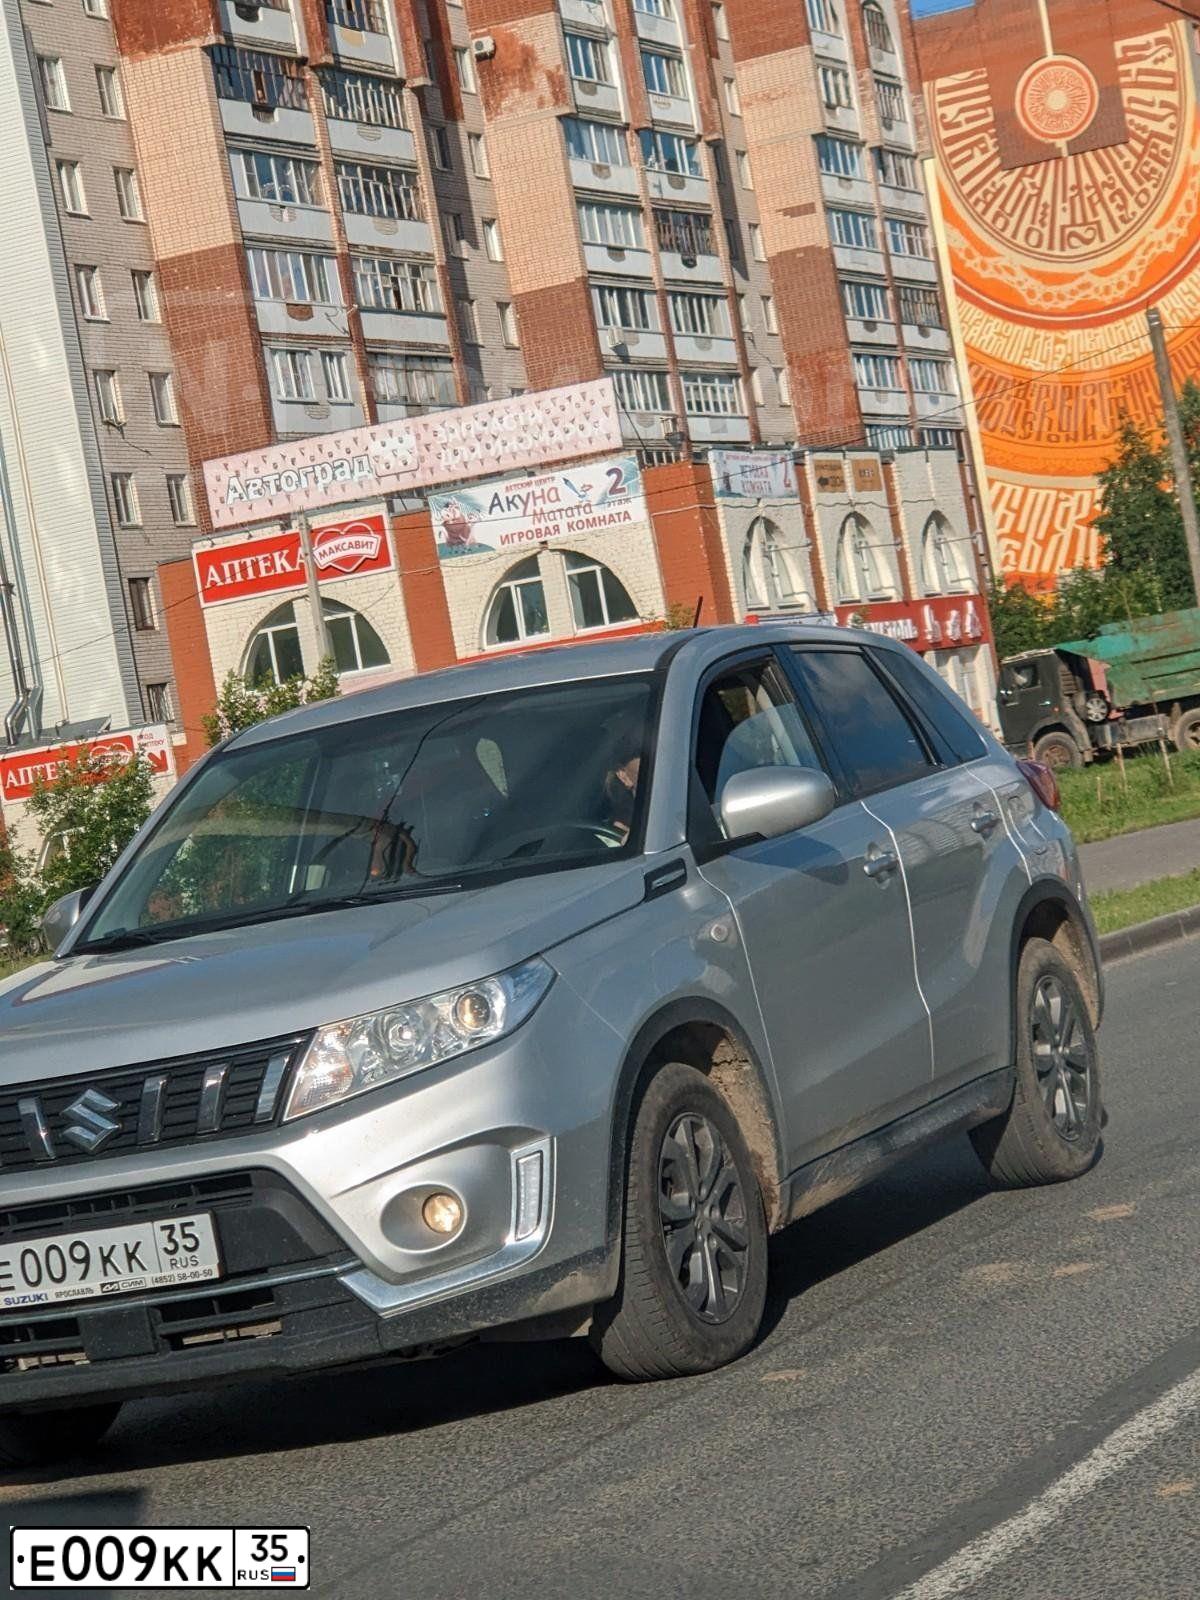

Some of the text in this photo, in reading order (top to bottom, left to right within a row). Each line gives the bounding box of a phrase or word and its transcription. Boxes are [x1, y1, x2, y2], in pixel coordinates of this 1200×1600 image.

[226, 454, 377, 505] Автоград
[605, 467, 627, 496] 2
[488, 486, 561, 517] Акуна
[532, 502, 593, 526] Матата
[499, 510, 632, 546] ИГРОВАЯ КОМНАТА
[317, 539, 374, 561] МАКСАВИТ
[160, 1221, 200, 1255] 35
[169, 1255, 200, 1270] RUS
[4, 1292, 49, 1307] SUZUKI
